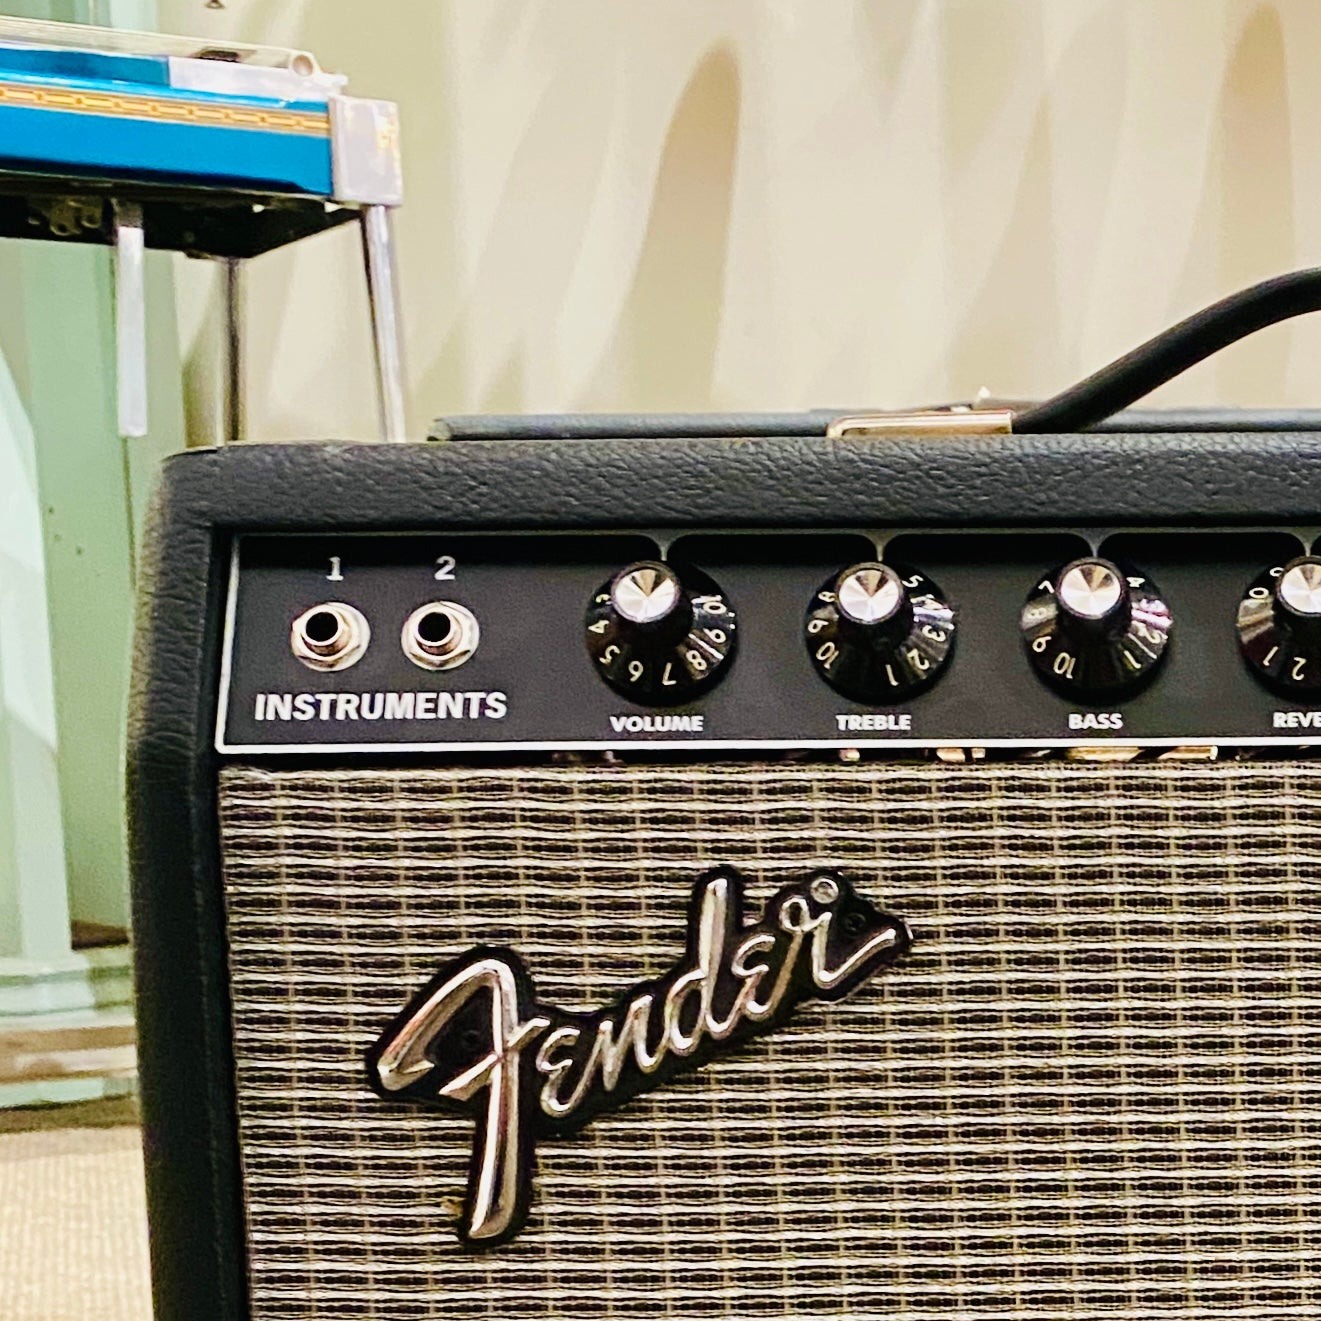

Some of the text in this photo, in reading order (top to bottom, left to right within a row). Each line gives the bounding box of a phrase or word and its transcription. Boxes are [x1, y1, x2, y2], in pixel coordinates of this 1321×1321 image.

[326, 557, 343, 580] 1
[435, 556, 456, 580] 2
[902, 575, 924, 588] 5
[588, 620, 610, 634] 4
[922, 625, 946, 642] 3
[1038, 580, 1055, 594] 7
[1053, 652, 1076, 679] 10
[600, 645, 621, 665] 5
[686, 650, 707, 670] 8
[816, 642, 839, 669] 10
[907, 649, 930, 670] 2
[1263, 646, 1279, 666] 1
[1292, 657, 1307, 680] 2
[628, 661, 644, 682] 6
[662, 662, 677, 685] 7
[885, 664, 899, 686] 1
[254, 691, 508, 721] INSTRUMENTS
[609, 715, 705, 733] VOLUME
[835, 714, 912, 732] TREBLE
[1068, 713, 1124, 730] BASS
[374, 875, 899, 1241] Fender
